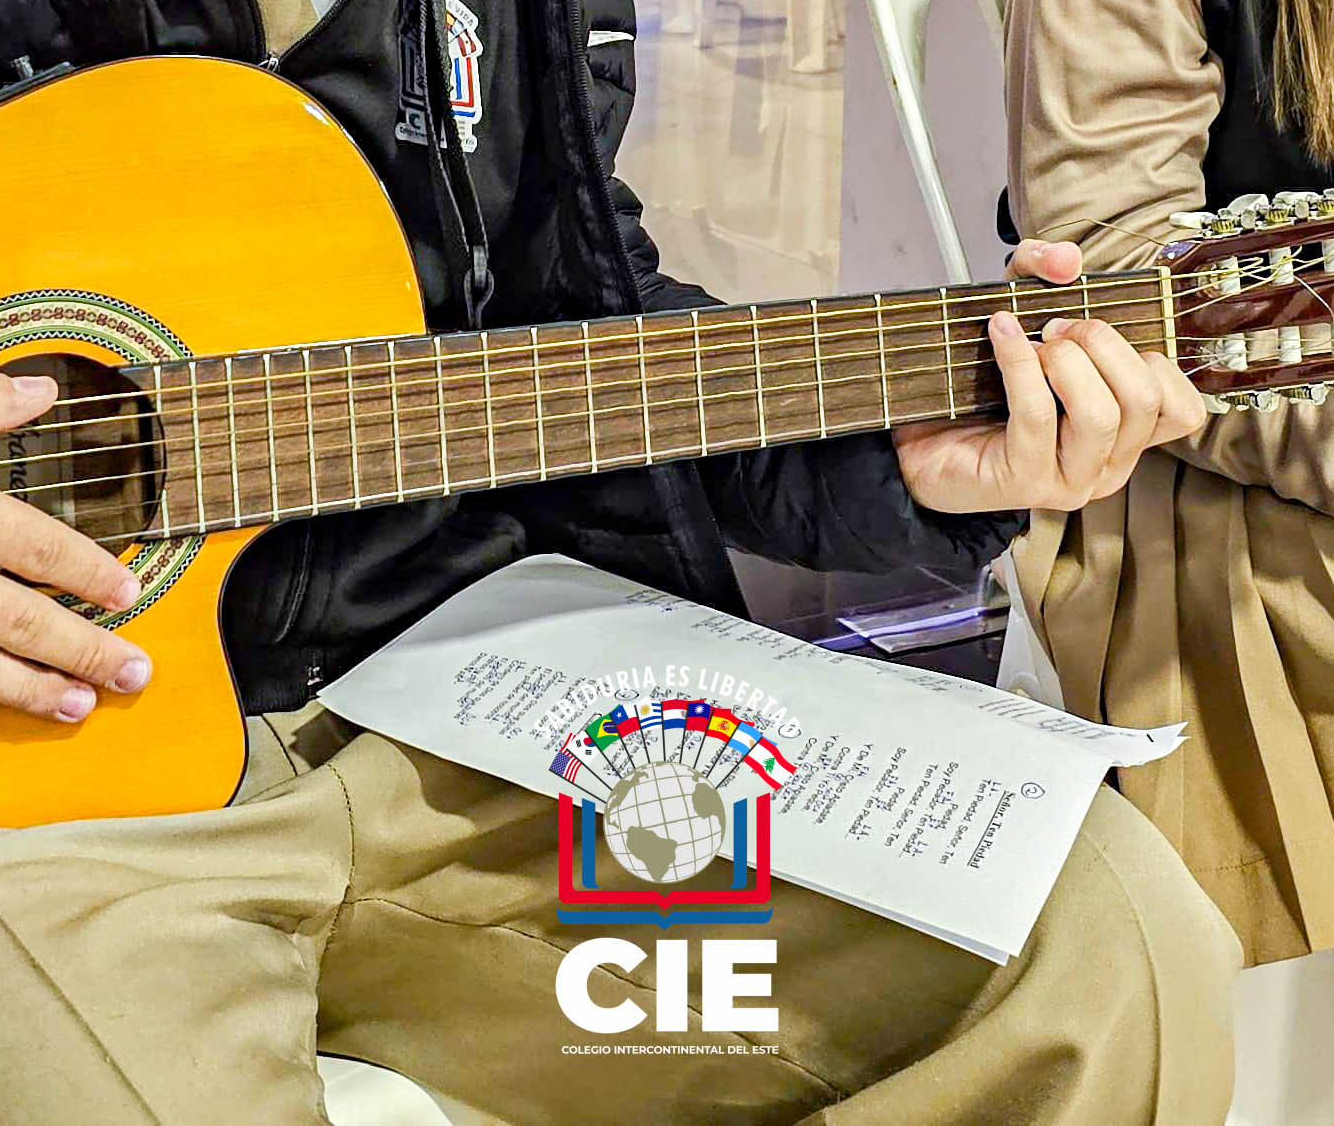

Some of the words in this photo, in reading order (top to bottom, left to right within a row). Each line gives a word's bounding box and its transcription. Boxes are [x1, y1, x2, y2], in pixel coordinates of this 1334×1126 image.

[922, 762, 938, 780] Ten
[942, 759, 959, 778] Soy
[976, 776, 992, 795] Ten
[993, 789, 1017, 822] Señor,
[985, 819, 1002, 839] Ten
[883, 830, 899, 849] Ten
[937, 848, 954, 867] Ten
[968, 837, 993, 870] Piedad
